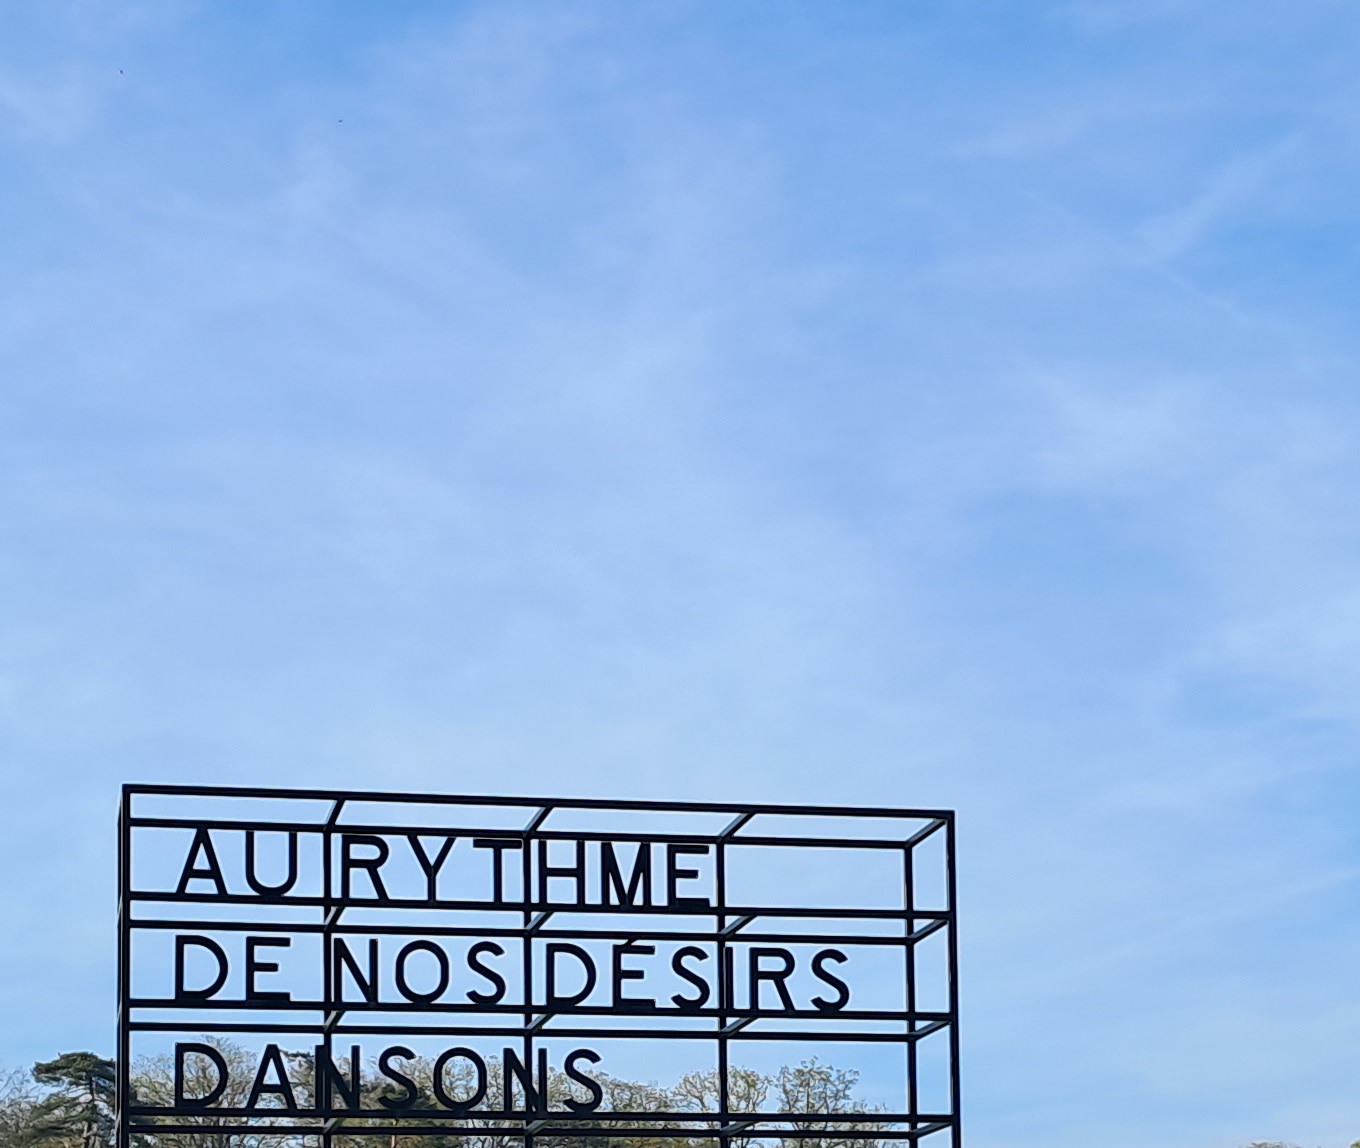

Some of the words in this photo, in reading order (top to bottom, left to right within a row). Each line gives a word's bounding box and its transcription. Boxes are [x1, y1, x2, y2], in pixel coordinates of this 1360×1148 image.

[176, 828, 298, 896] AU
[341, 835, 710, 908] RYTHME
[175, 934, 291, 1003] DE
[333, 938, 506, 1005] NOS
[546, 937, 850, 1012] DÉSIRS
[175, 1042, 603, 1112] DANSONS
